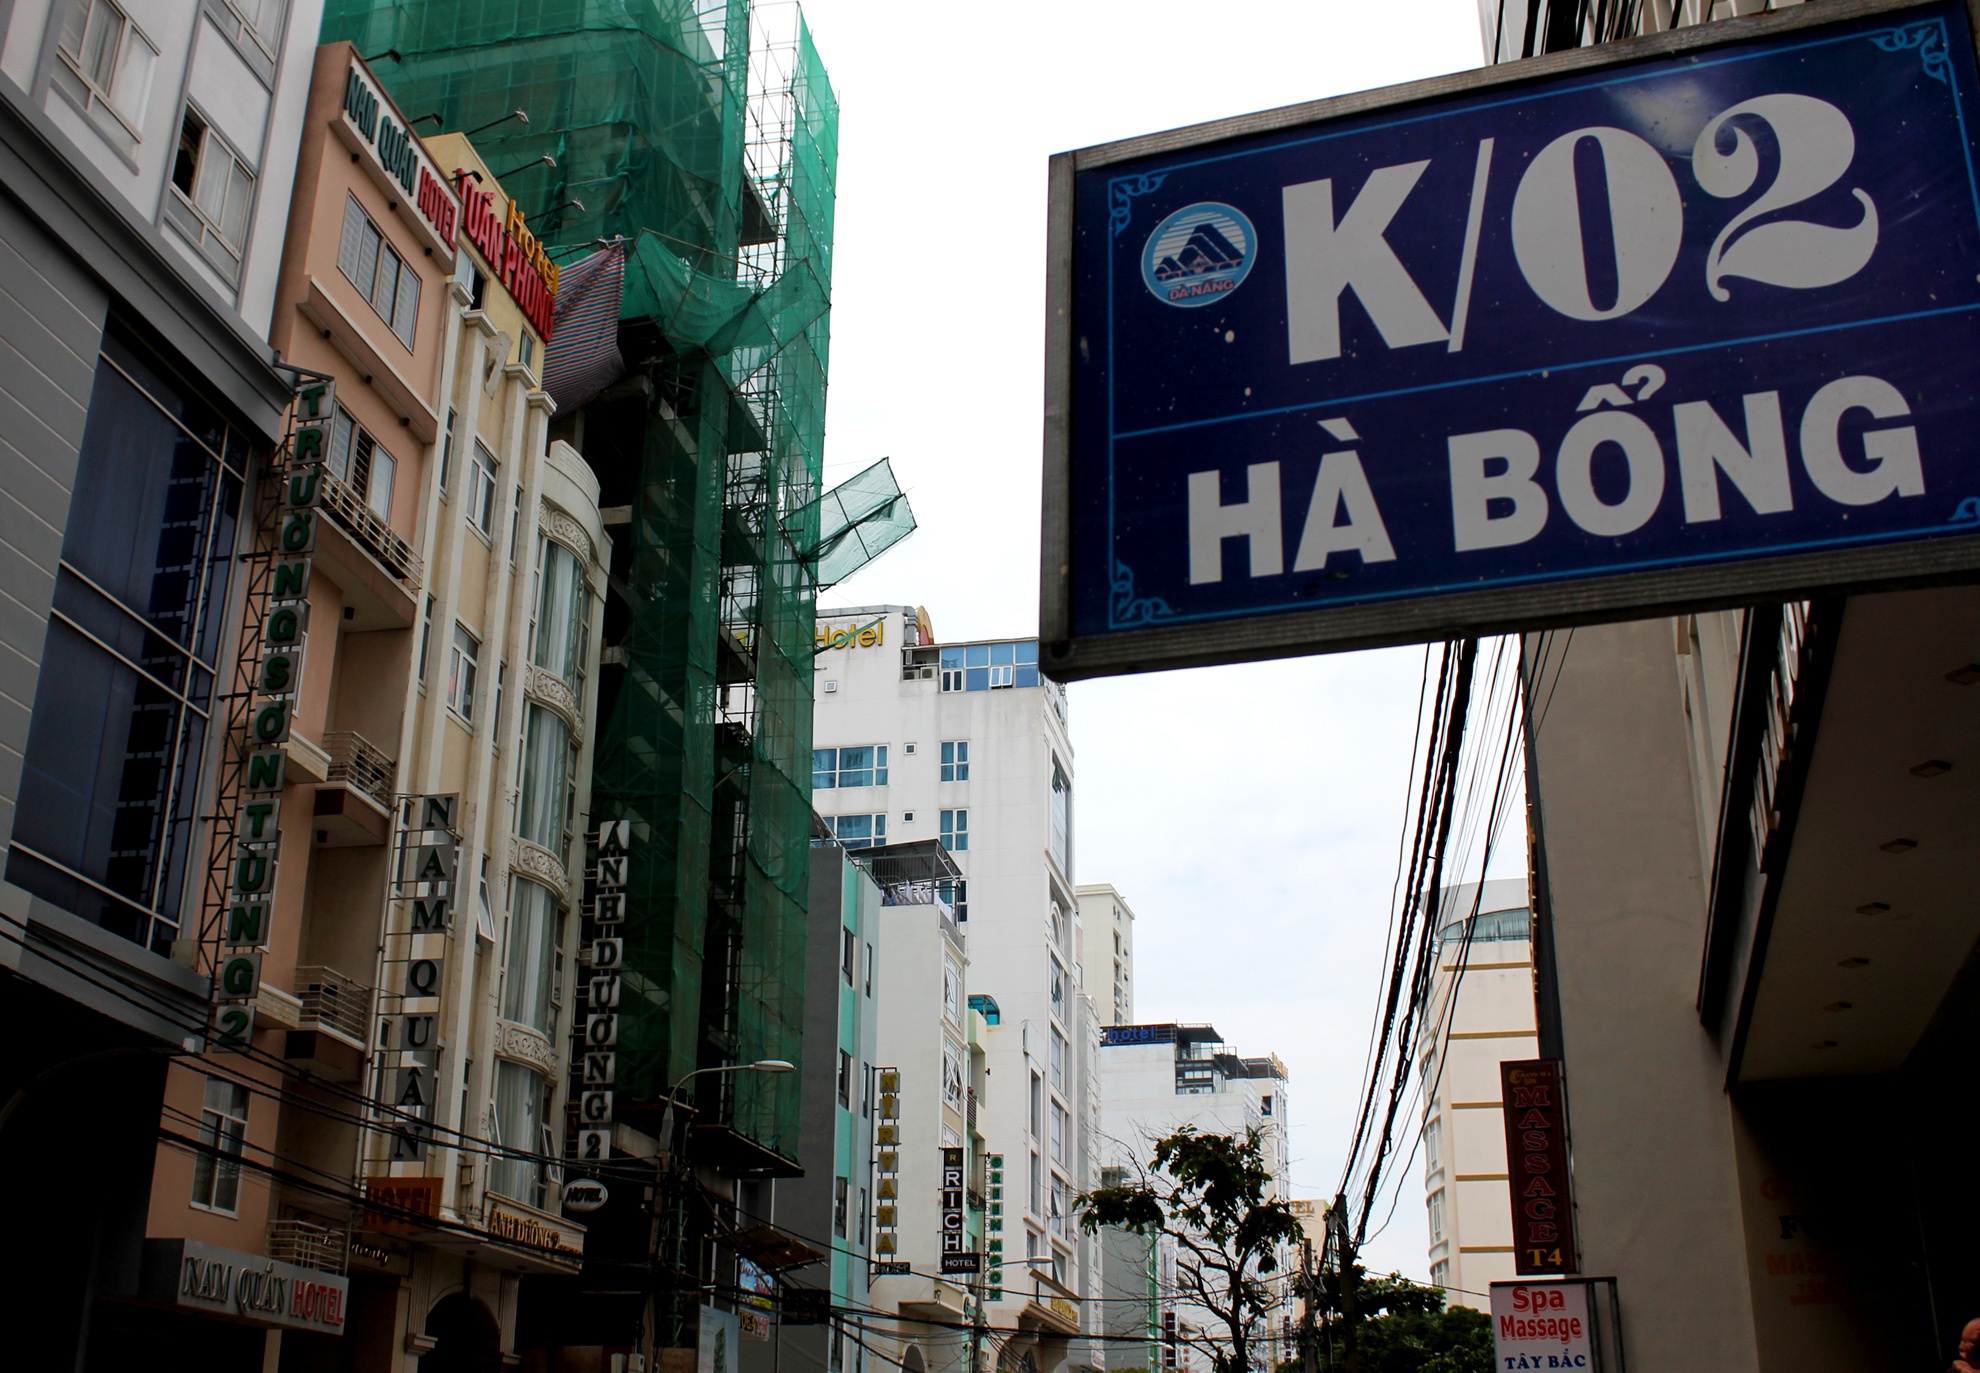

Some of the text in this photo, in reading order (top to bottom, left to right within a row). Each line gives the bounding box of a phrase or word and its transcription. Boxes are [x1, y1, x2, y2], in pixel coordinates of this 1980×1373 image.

[345, 66, 379, 144] NAM
[417, 166, 457, 252] HOTEL
[507, 199, 561, 296] Hotel
[1282, 93, 1879, 365] K/02
[1188, 364, 1926, 585] HÀ BỔNG
[411, 797, 454, 930] NAM
[1110, 1026, 1155, 1040] hotel
[990, 1157, 1002, 1231] GREEN
[1513, 1086, 1558, 1243] MASSAGE
[945, 1171, 960, 1251] RICH
[183, 1256, 233, 1303] NAM
[289, 1278, 344, 1326] HOTEL
[945, 1259, 976, 1267] HOTEL
[1527, 1248, 1562, 1267] T4
[1501, 1315, 1582, 1344] Massage
[1512, 1286, 1566, 1317] Spa
[1505, 1348, 1586, 1370] TÂY BẮC
